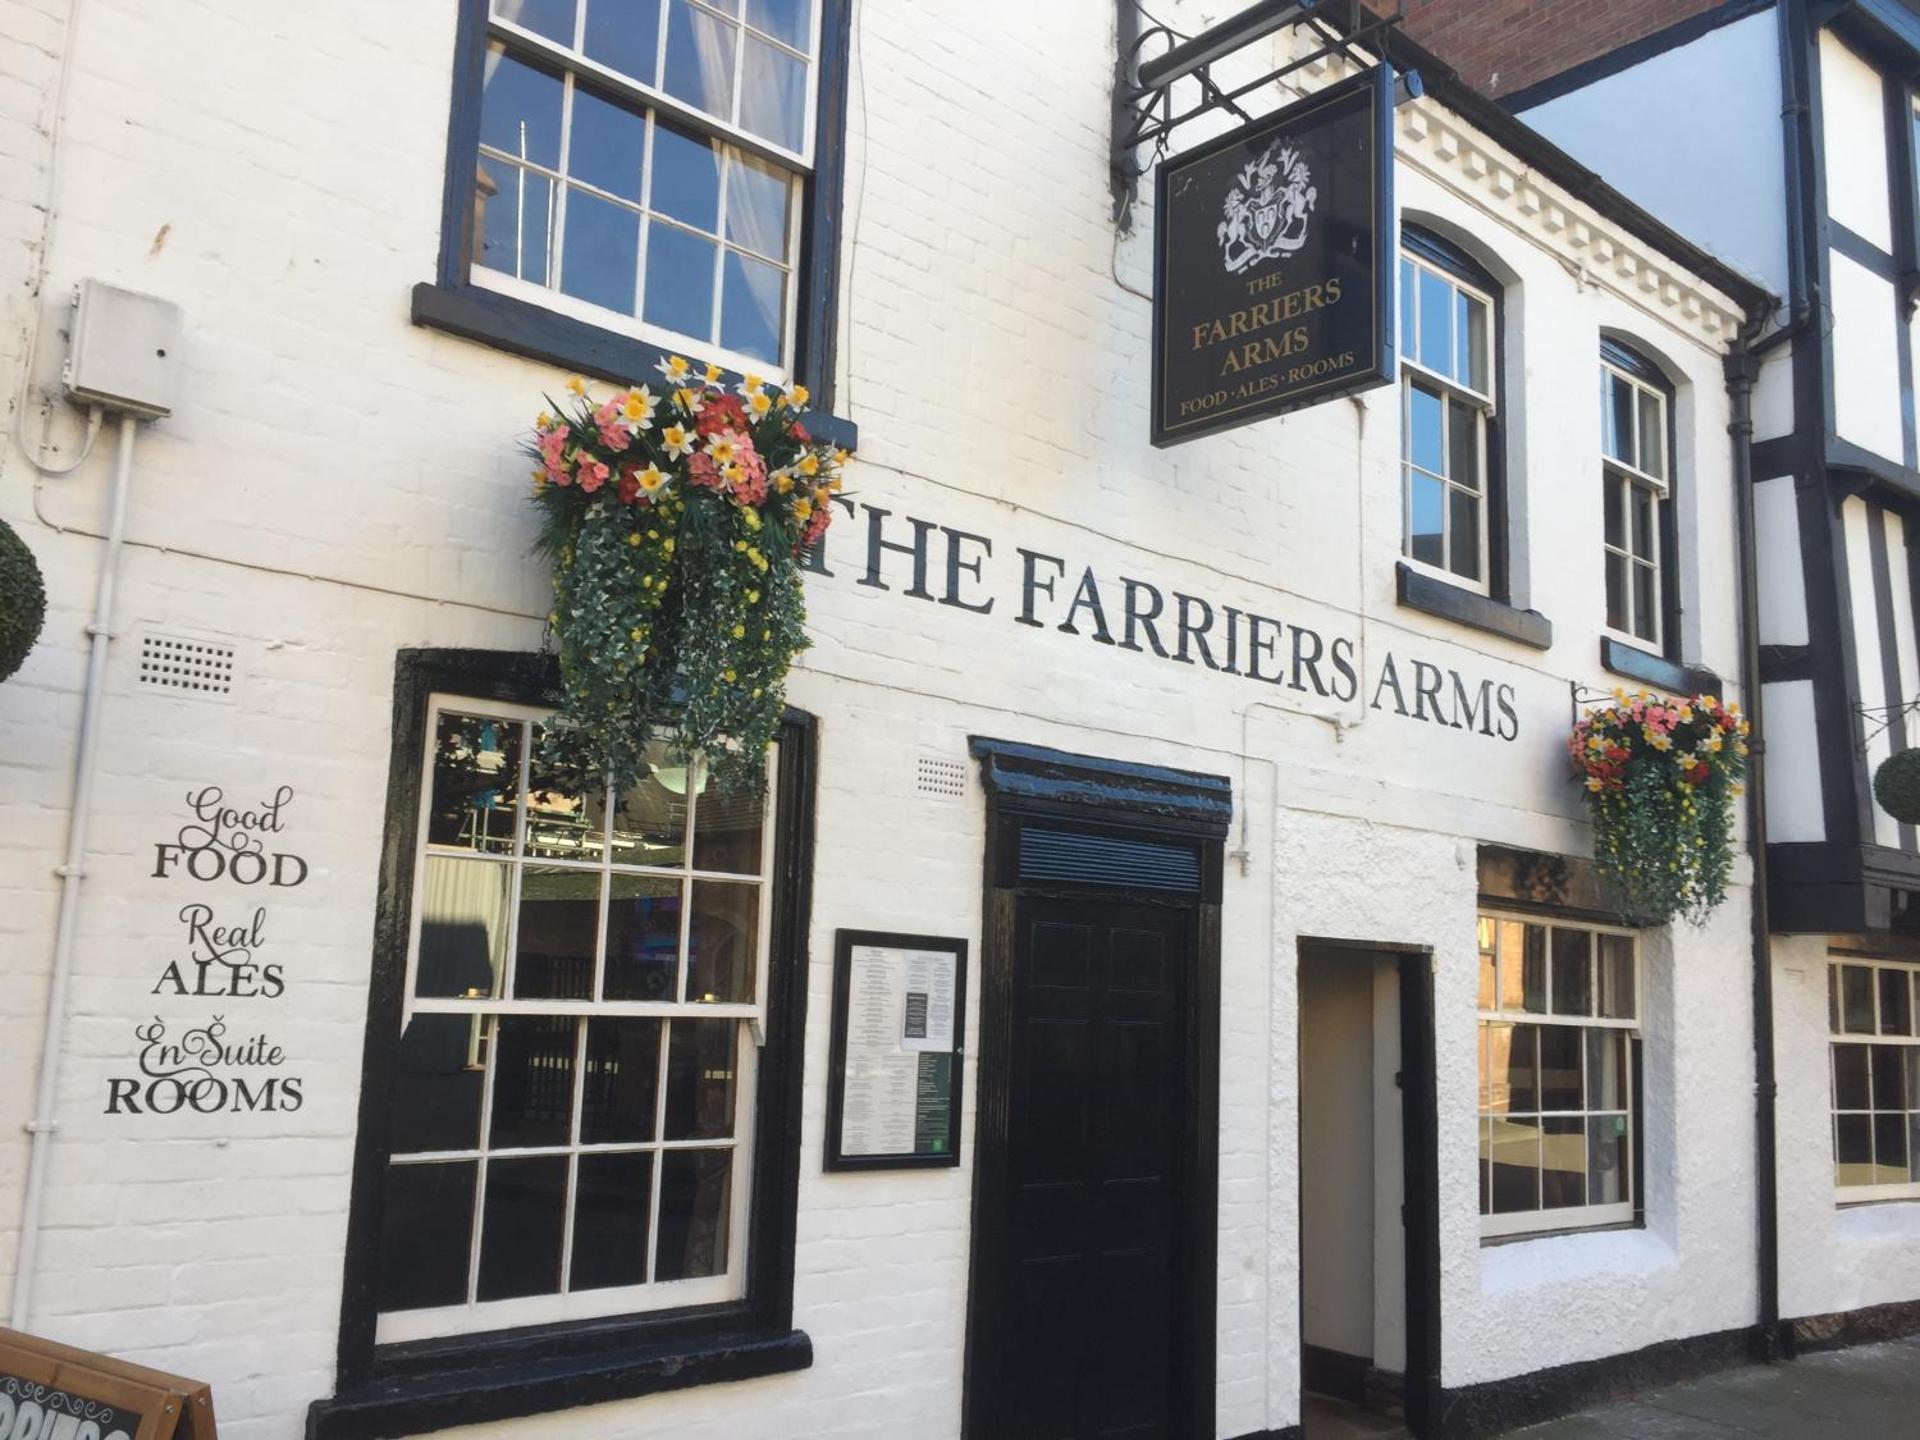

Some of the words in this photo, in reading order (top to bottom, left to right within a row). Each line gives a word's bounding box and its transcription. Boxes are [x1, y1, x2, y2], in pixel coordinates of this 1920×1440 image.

[1247, 272, 1282, 295] THE
[1192, 278, 1342, 350] FARRIERS
[1220, 327, 1309, 375] ARMS
[1180, 389, 1228, 417] FOOD
[1288, 351, 1354, 382] ROOMS
[802, 497, 994, 615] THE
[1014, 546, 1358, 703] FARRIERS
[1370, 651, 1520, 743] ARMS
[179, 786, 293, 855] Good
[150, 843, 308, 887] FOOD
[179, 903, 266, 966] Real
[151, 959, 285, 998] ALES
[104, 1077, 304, 1115] ROOMS
